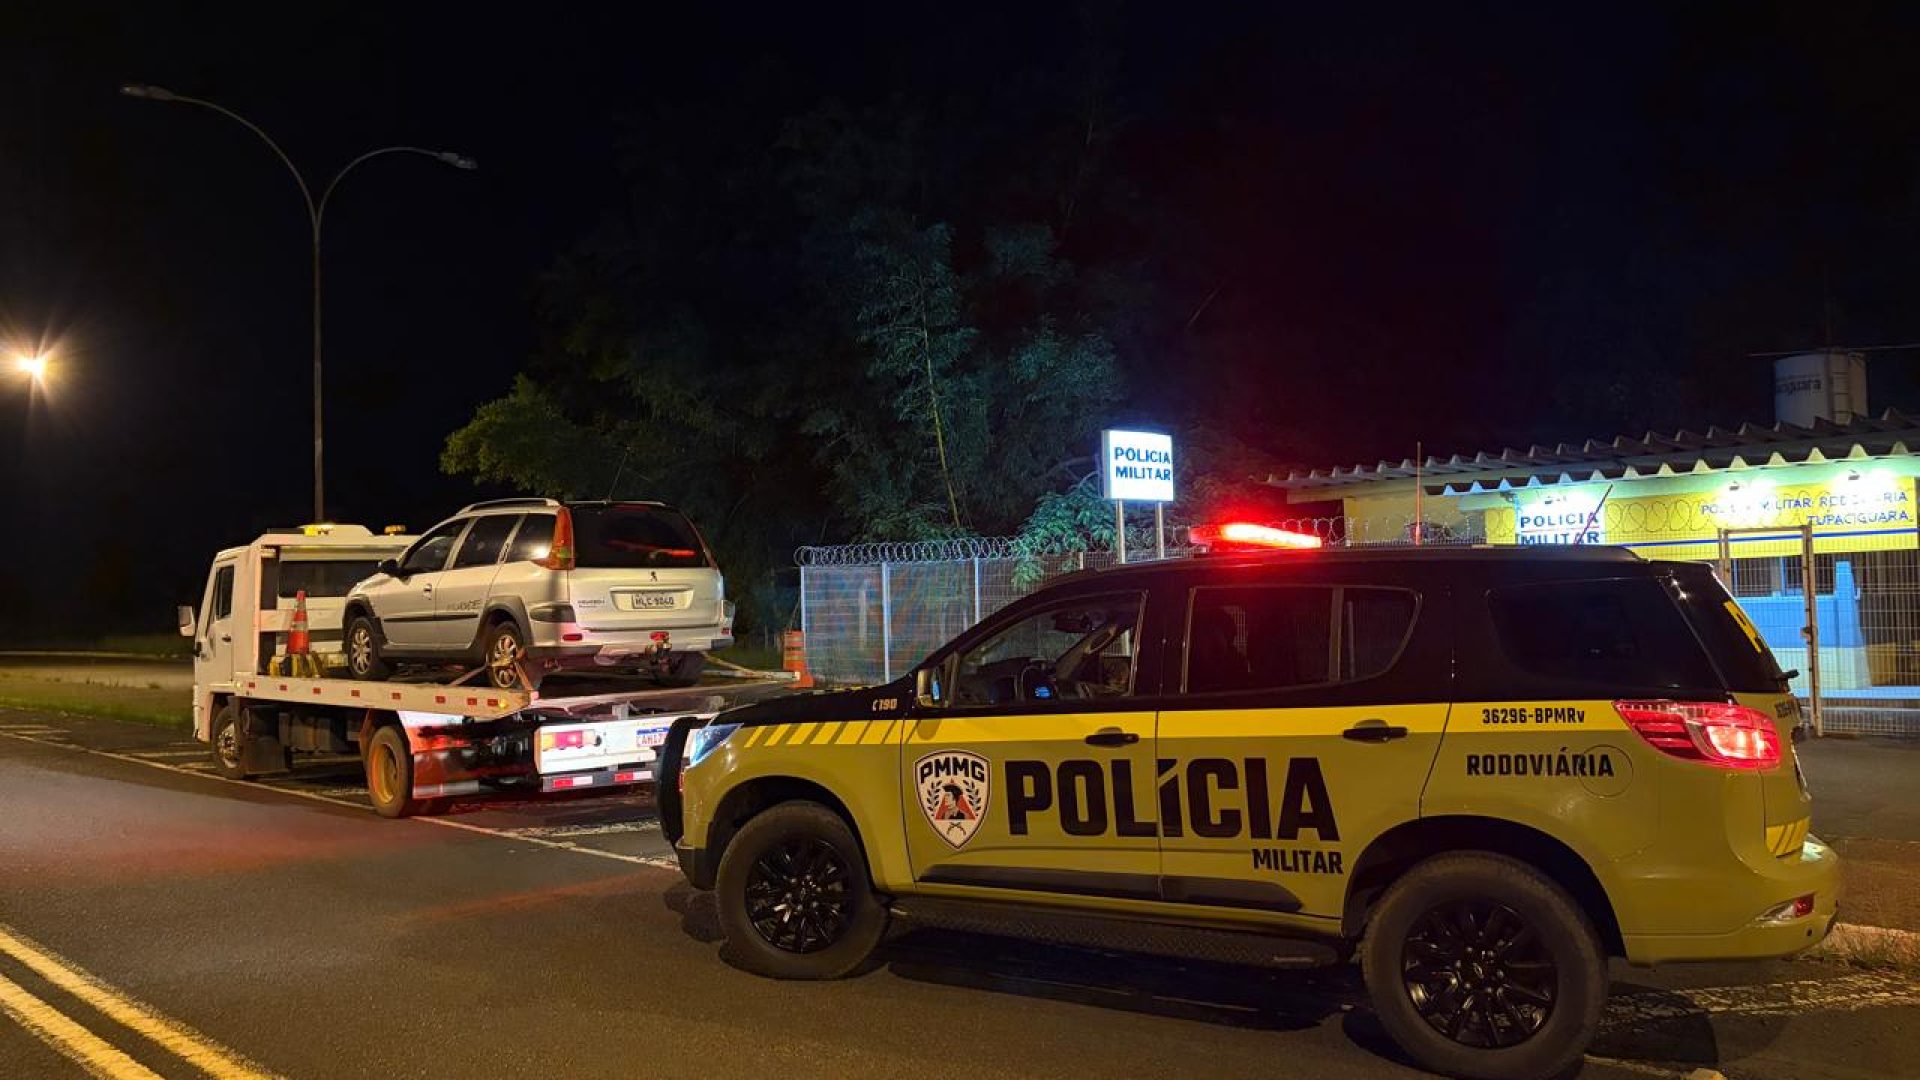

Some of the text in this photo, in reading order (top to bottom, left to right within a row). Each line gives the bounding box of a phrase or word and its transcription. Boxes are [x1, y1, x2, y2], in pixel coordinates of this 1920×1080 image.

[1114, 447, 1171, 464] POLICIA
[1115, 466, 1171, 481] MILITAR
[1520, 512, 1600, 528] POLICIA
[1482, 707, 1585, 724] 36296-BPMRv
[920, 756, 985, 784] PMMG
[1466, 746, 1615, 777] RODOVIÁRIA
[1004, 757, 1341, 841] POLÍCIA
[1252, 848, 1344, 874] MILITAR
